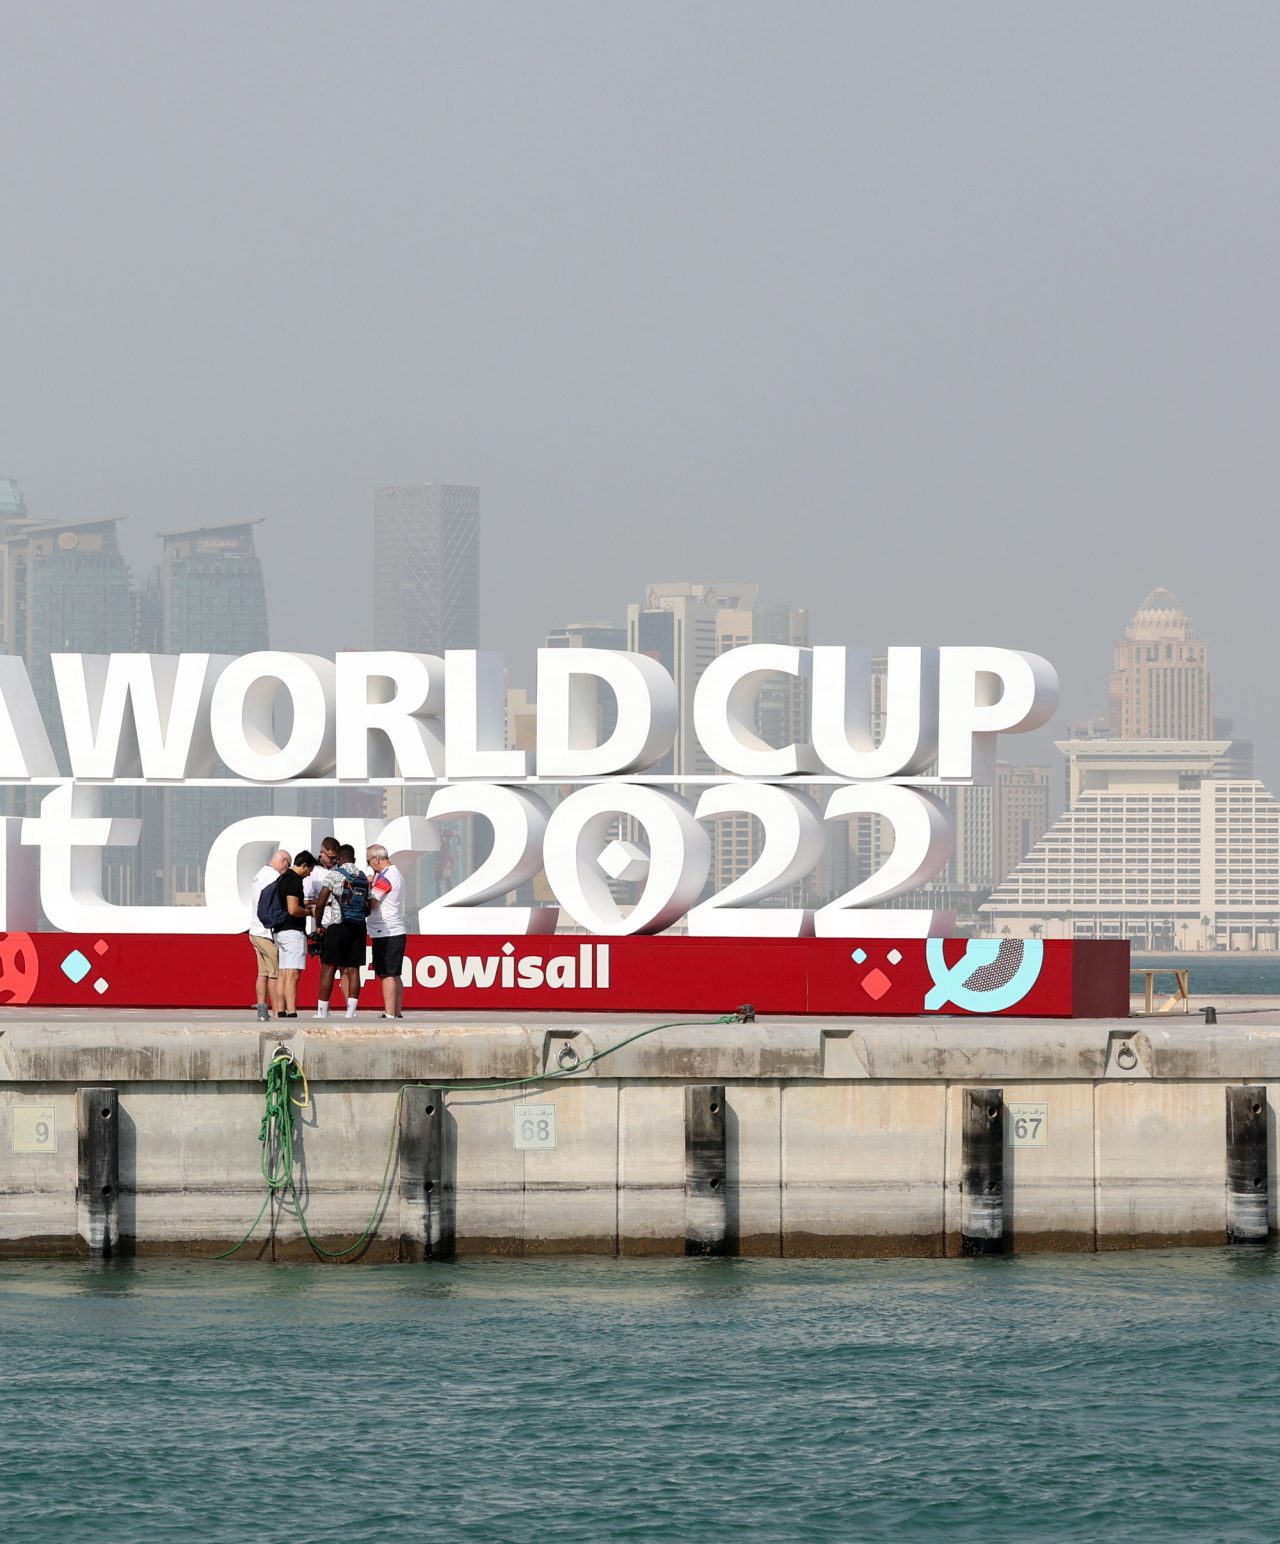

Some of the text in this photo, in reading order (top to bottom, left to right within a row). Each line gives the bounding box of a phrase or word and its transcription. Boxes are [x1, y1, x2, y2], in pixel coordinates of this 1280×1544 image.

[51, 646, 658, 783] WORLD
[692, 643, 1042, 779] CUP
[418, 782, 936, 938] 2022
[521, 1119, 549, 1141] 68
[1014, 1117, 1042, 1140] 67
